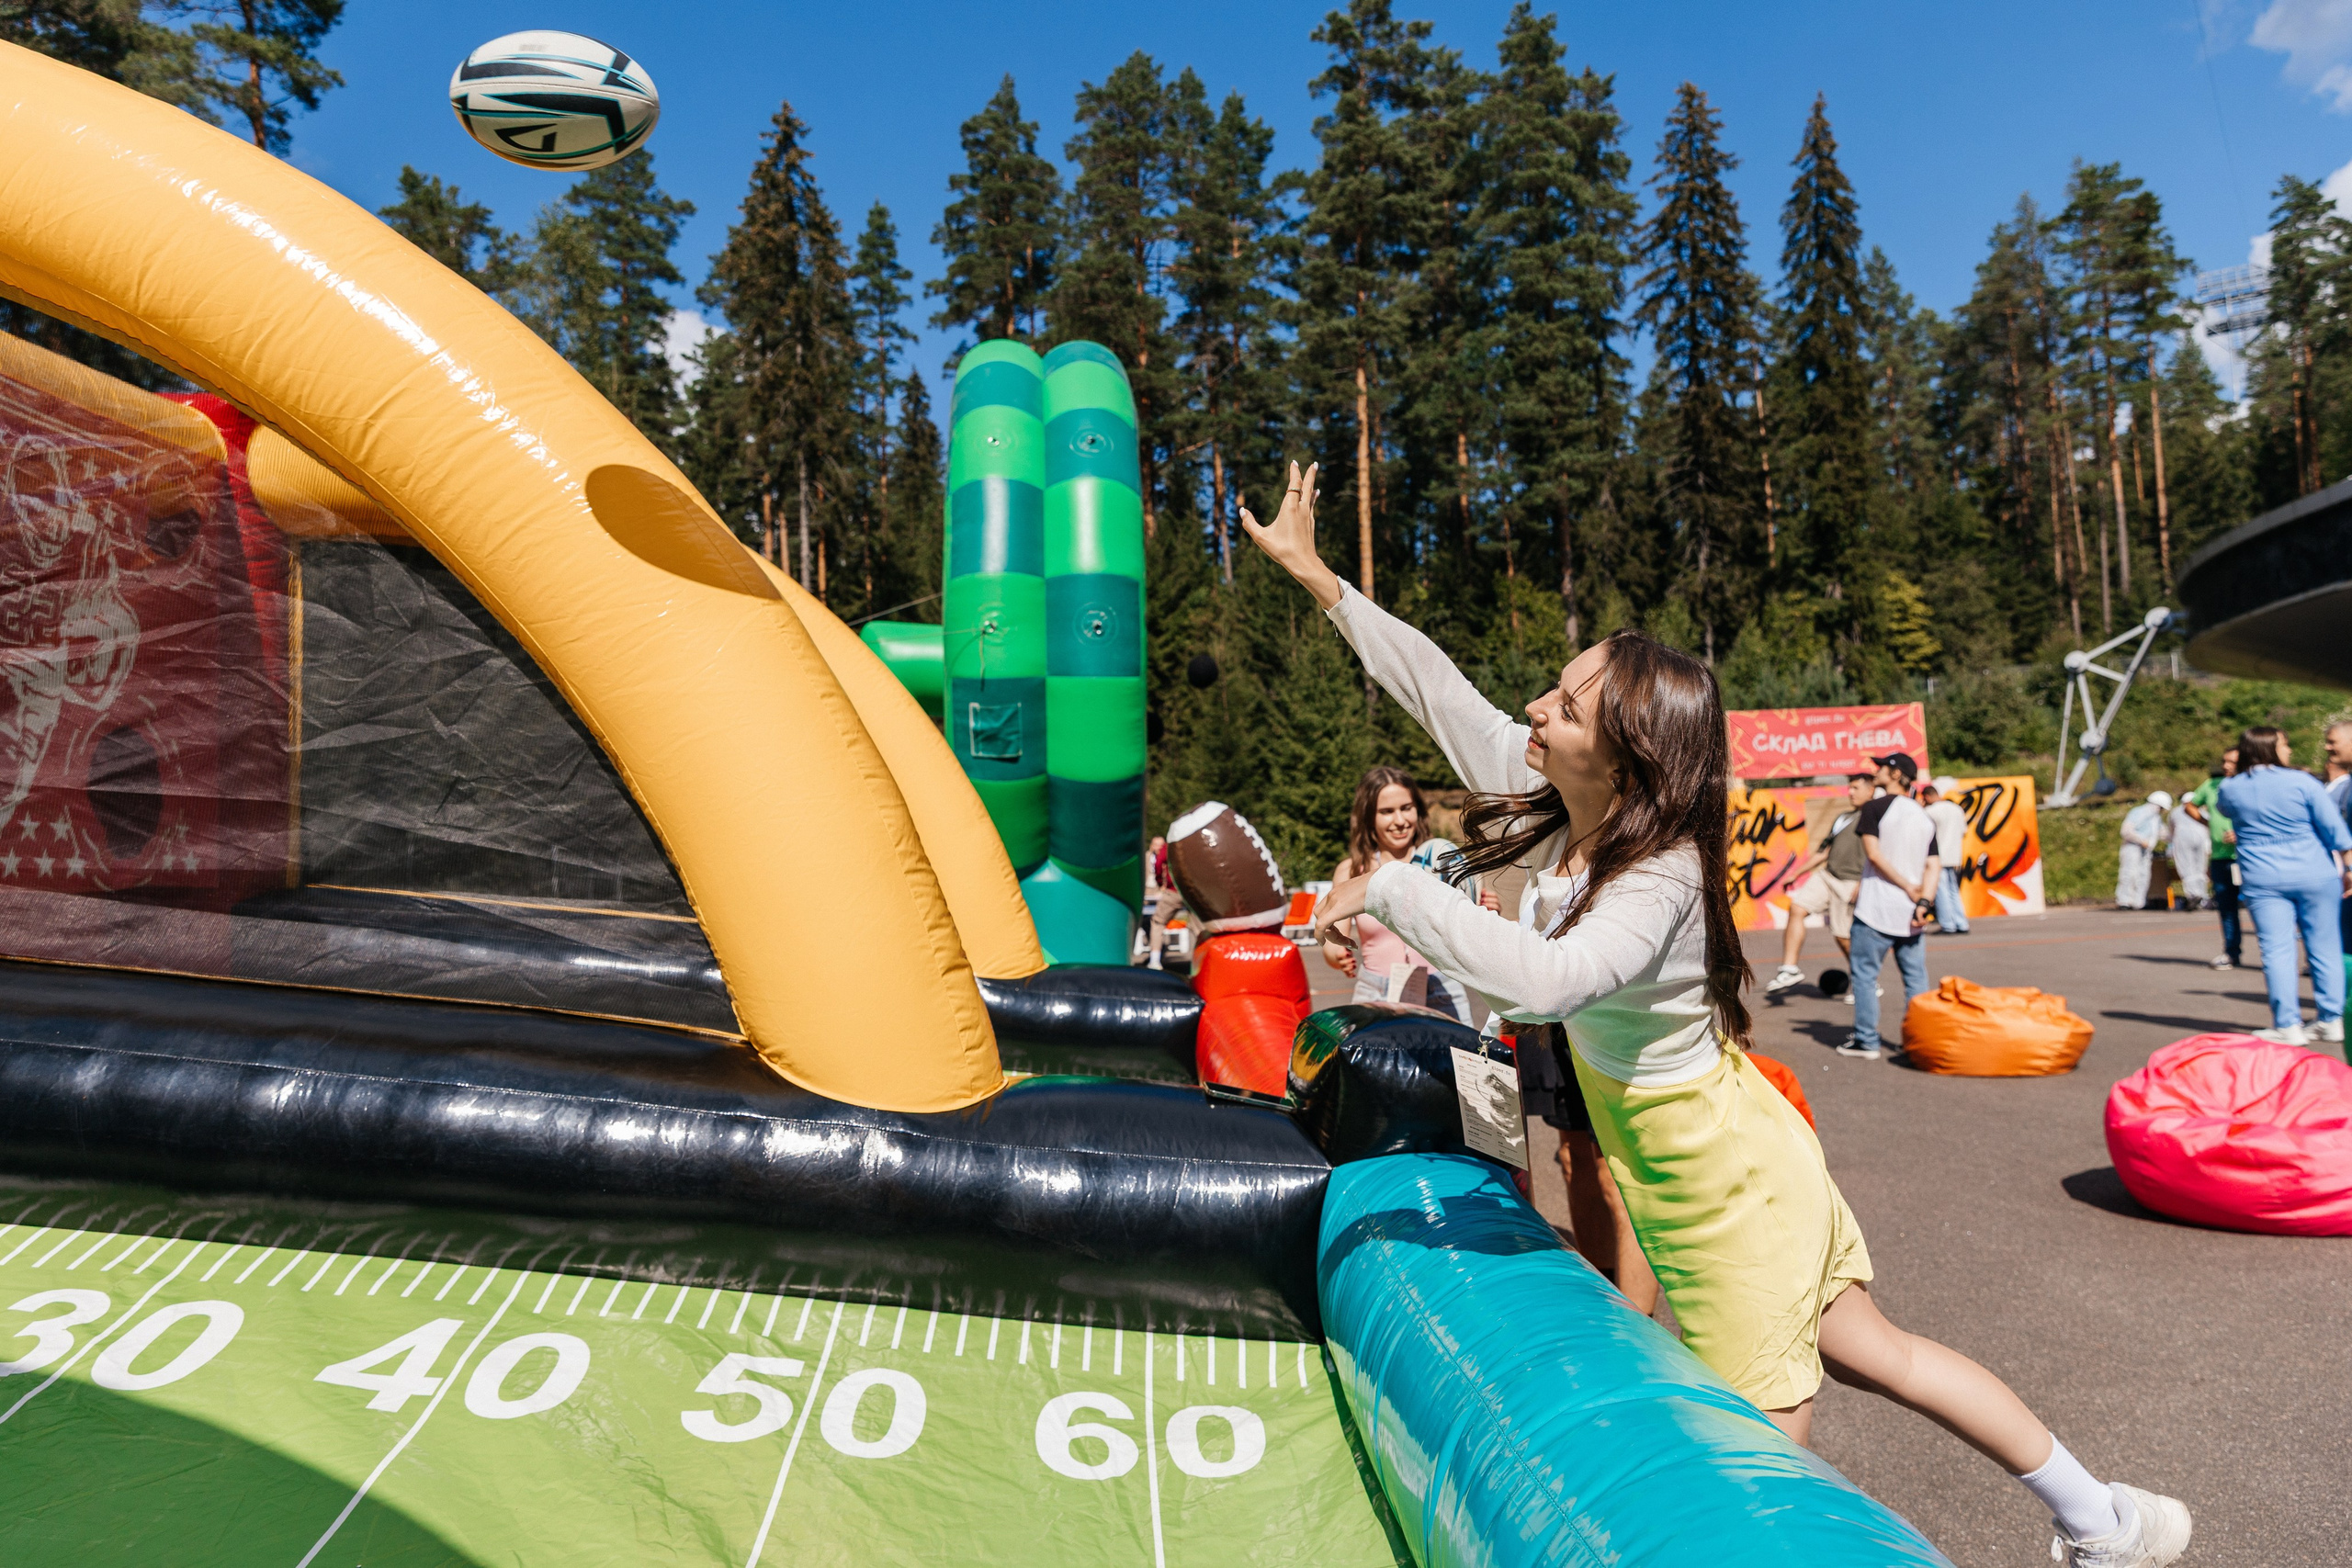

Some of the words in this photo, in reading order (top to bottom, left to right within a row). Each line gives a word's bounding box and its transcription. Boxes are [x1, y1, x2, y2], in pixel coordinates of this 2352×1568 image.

[1752, 731, 1827, 755] СКЛАД
[1834, 728, 1907, 750] ГНЕВА
[0, 1288, 245, 1391] 30
[314, 1318, 591, 1419] 40
[681, 1352, 927, 1459] 50
[1035, 1392, 1266, 1480] 60
